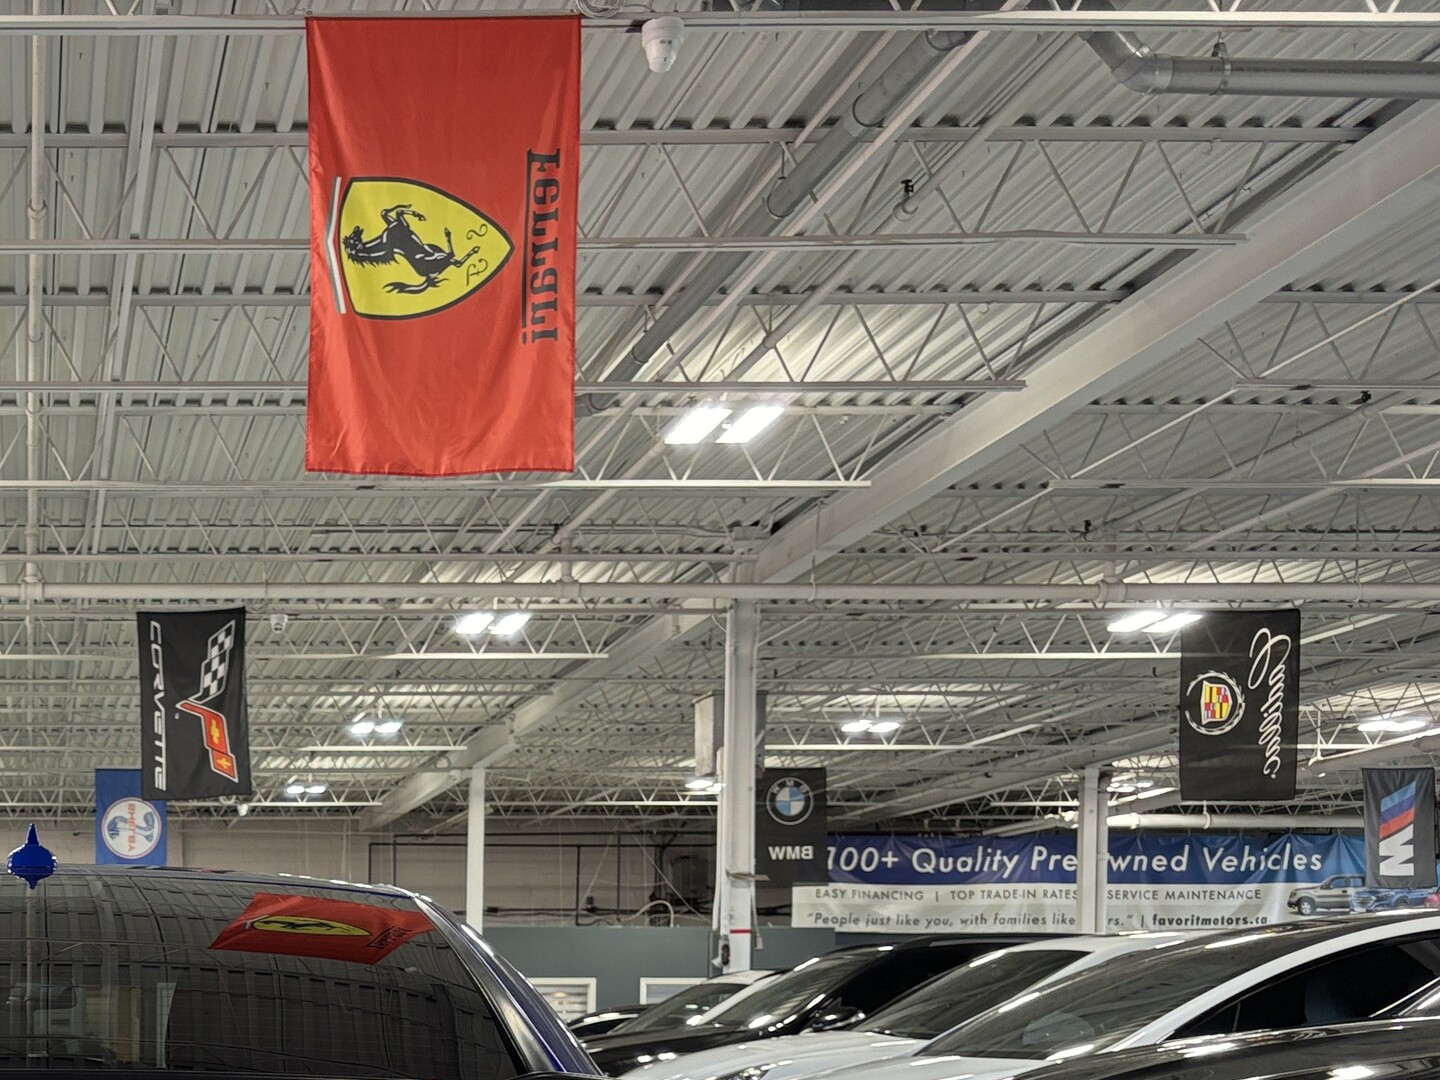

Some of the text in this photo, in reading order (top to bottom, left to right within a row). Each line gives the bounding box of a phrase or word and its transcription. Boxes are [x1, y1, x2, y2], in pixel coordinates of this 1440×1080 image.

[150, 620, 167, 792] CORVETTE
[912, 846, 1020, 879] Quality
[1203, 843, 1322, 872] Vehicles
[815, 889, 1262, 901] EASY FINANCING TOP TRADE-IN RATES SERVICE MAINTENANCE
[866, 913, 891, 927] just
[896, 913, 920, 926] like
[960, 914, 987, 926] with
[993, 913, 1047, 926] families
[1052, 913, 1076, 926] like
[1152, 914, 1268, 926] favoritmotors.ca
